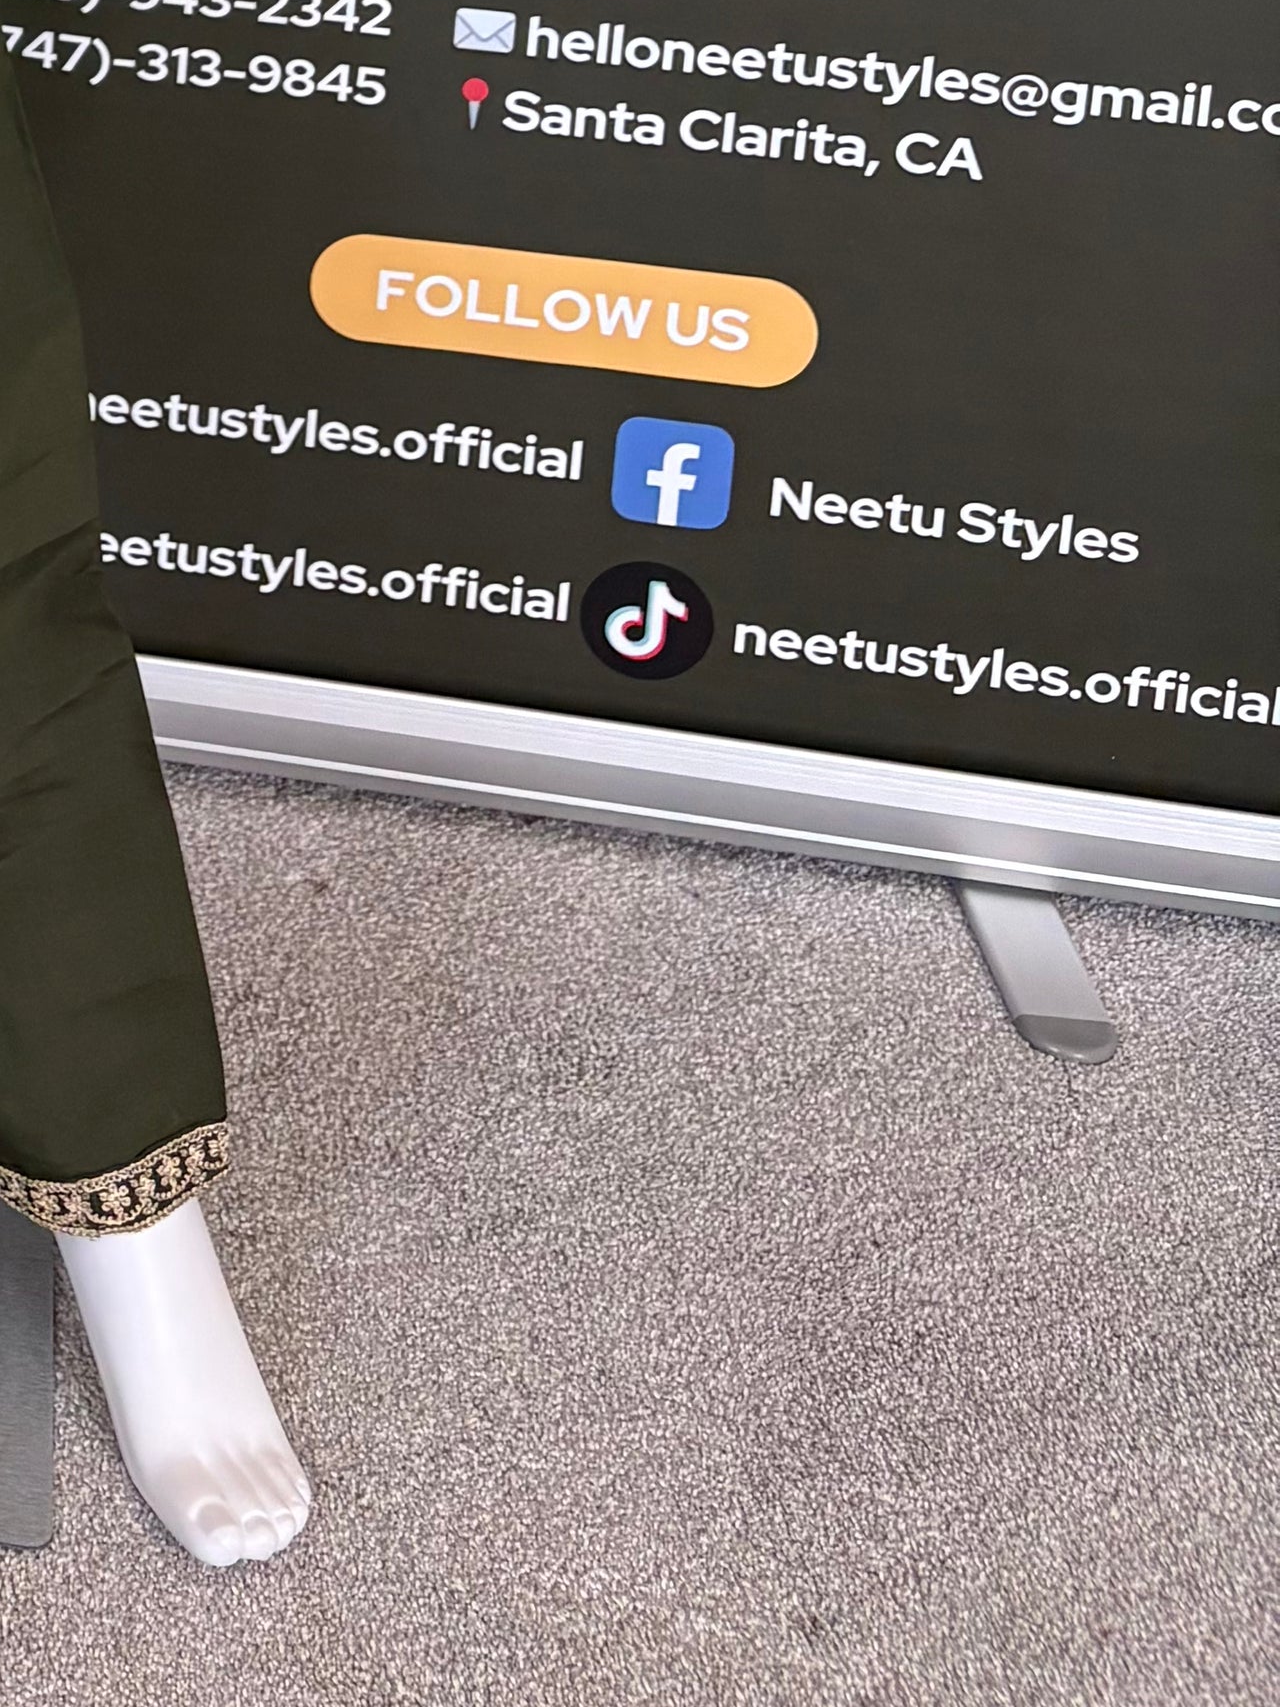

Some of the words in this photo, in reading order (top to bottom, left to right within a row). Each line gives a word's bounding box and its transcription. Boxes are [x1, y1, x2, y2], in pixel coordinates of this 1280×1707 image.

[503, 91, 664, 145] Santa
[680, 110, 879, 176] Clarita,
[896, 133, 982, 180] CA
[376, 269, 652, 340] FOLLOW
[666, 302, 750, 351] US
[770, 478, 944, 537] Neetu
[957, 503, 1138, 562] Styles
[734, 624, 1280, 725] neetustyles.official
